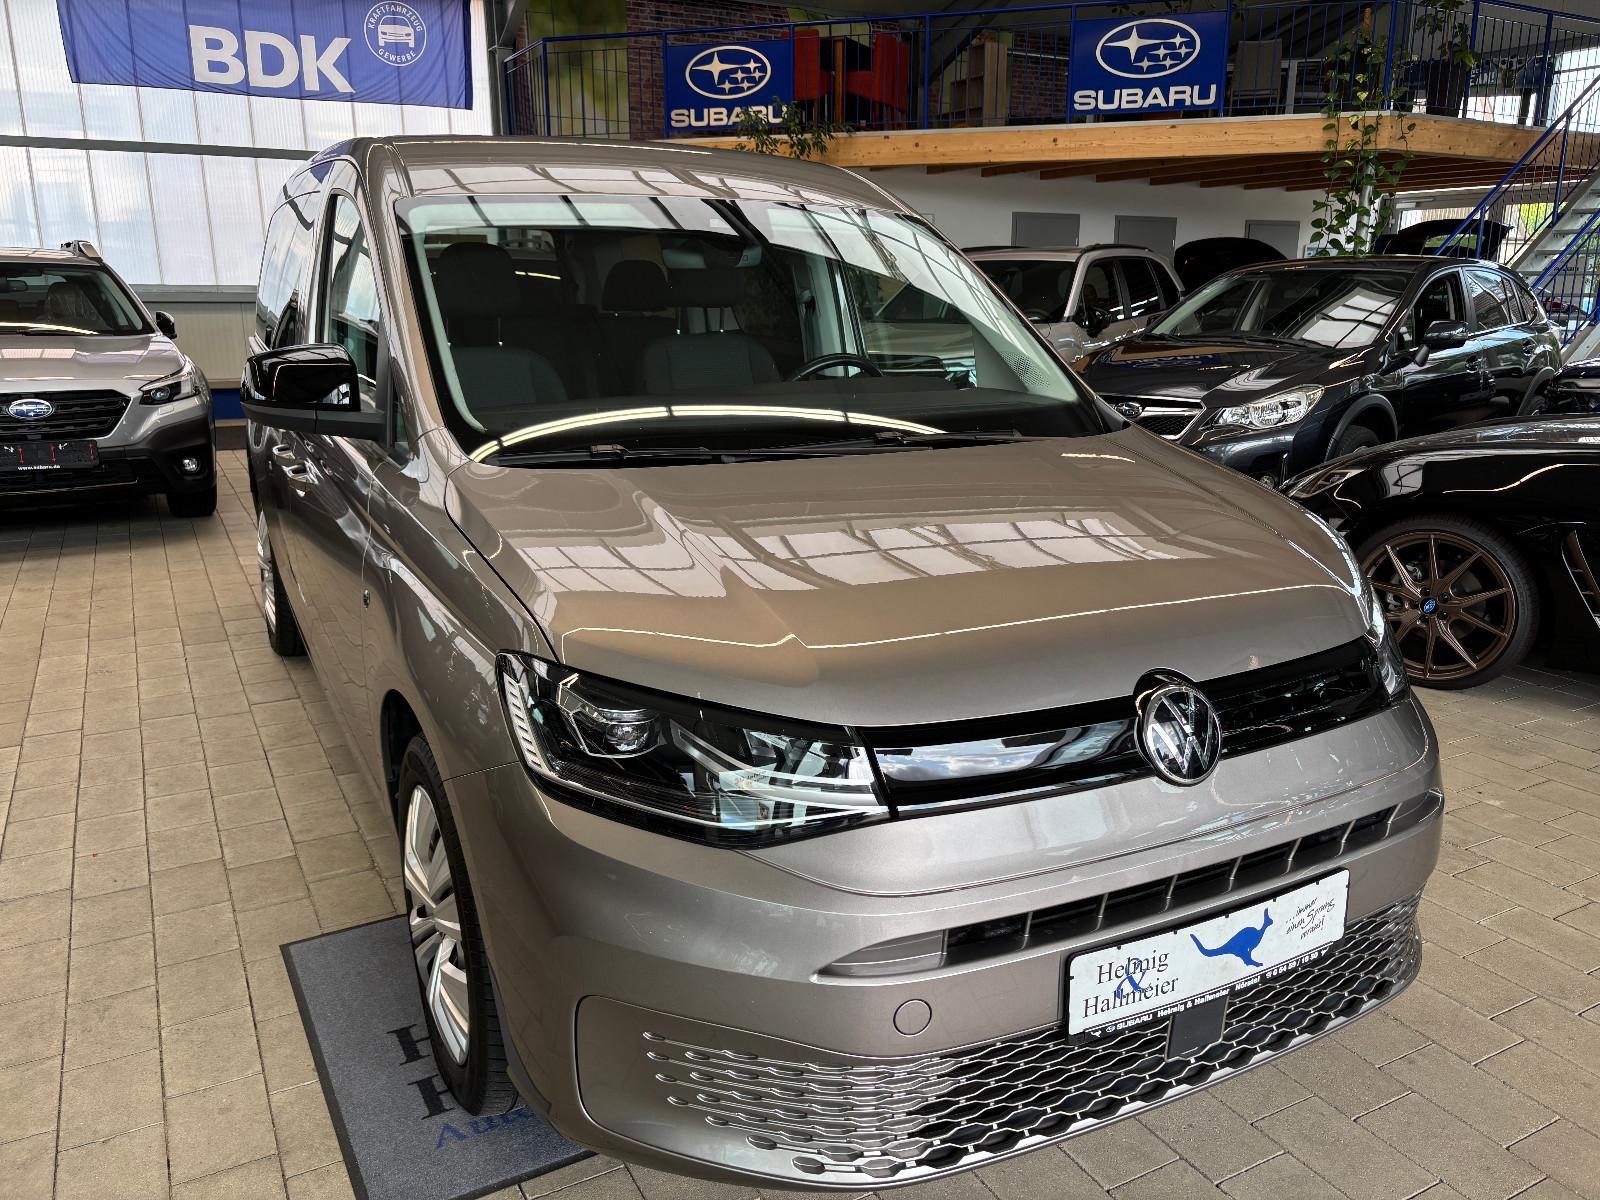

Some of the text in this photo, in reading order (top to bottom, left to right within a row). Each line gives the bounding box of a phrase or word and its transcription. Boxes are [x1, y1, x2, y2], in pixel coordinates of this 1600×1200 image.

[367, 4, 423, 32] KRAFTFAHRZEUG
[188, 24, 356, 93] BDK
[378, 48, 416, 63] GEWERBE
[1073, 84, 1218, 111] SUBARU
[1097, 950, 1170, 985] Helmig
[1082, 977, 1179, 1018] Hallmeier
[1116, 1014, 1153, 1030] SUBARU
[1157, 1004, 1184, 1018] Helmig
